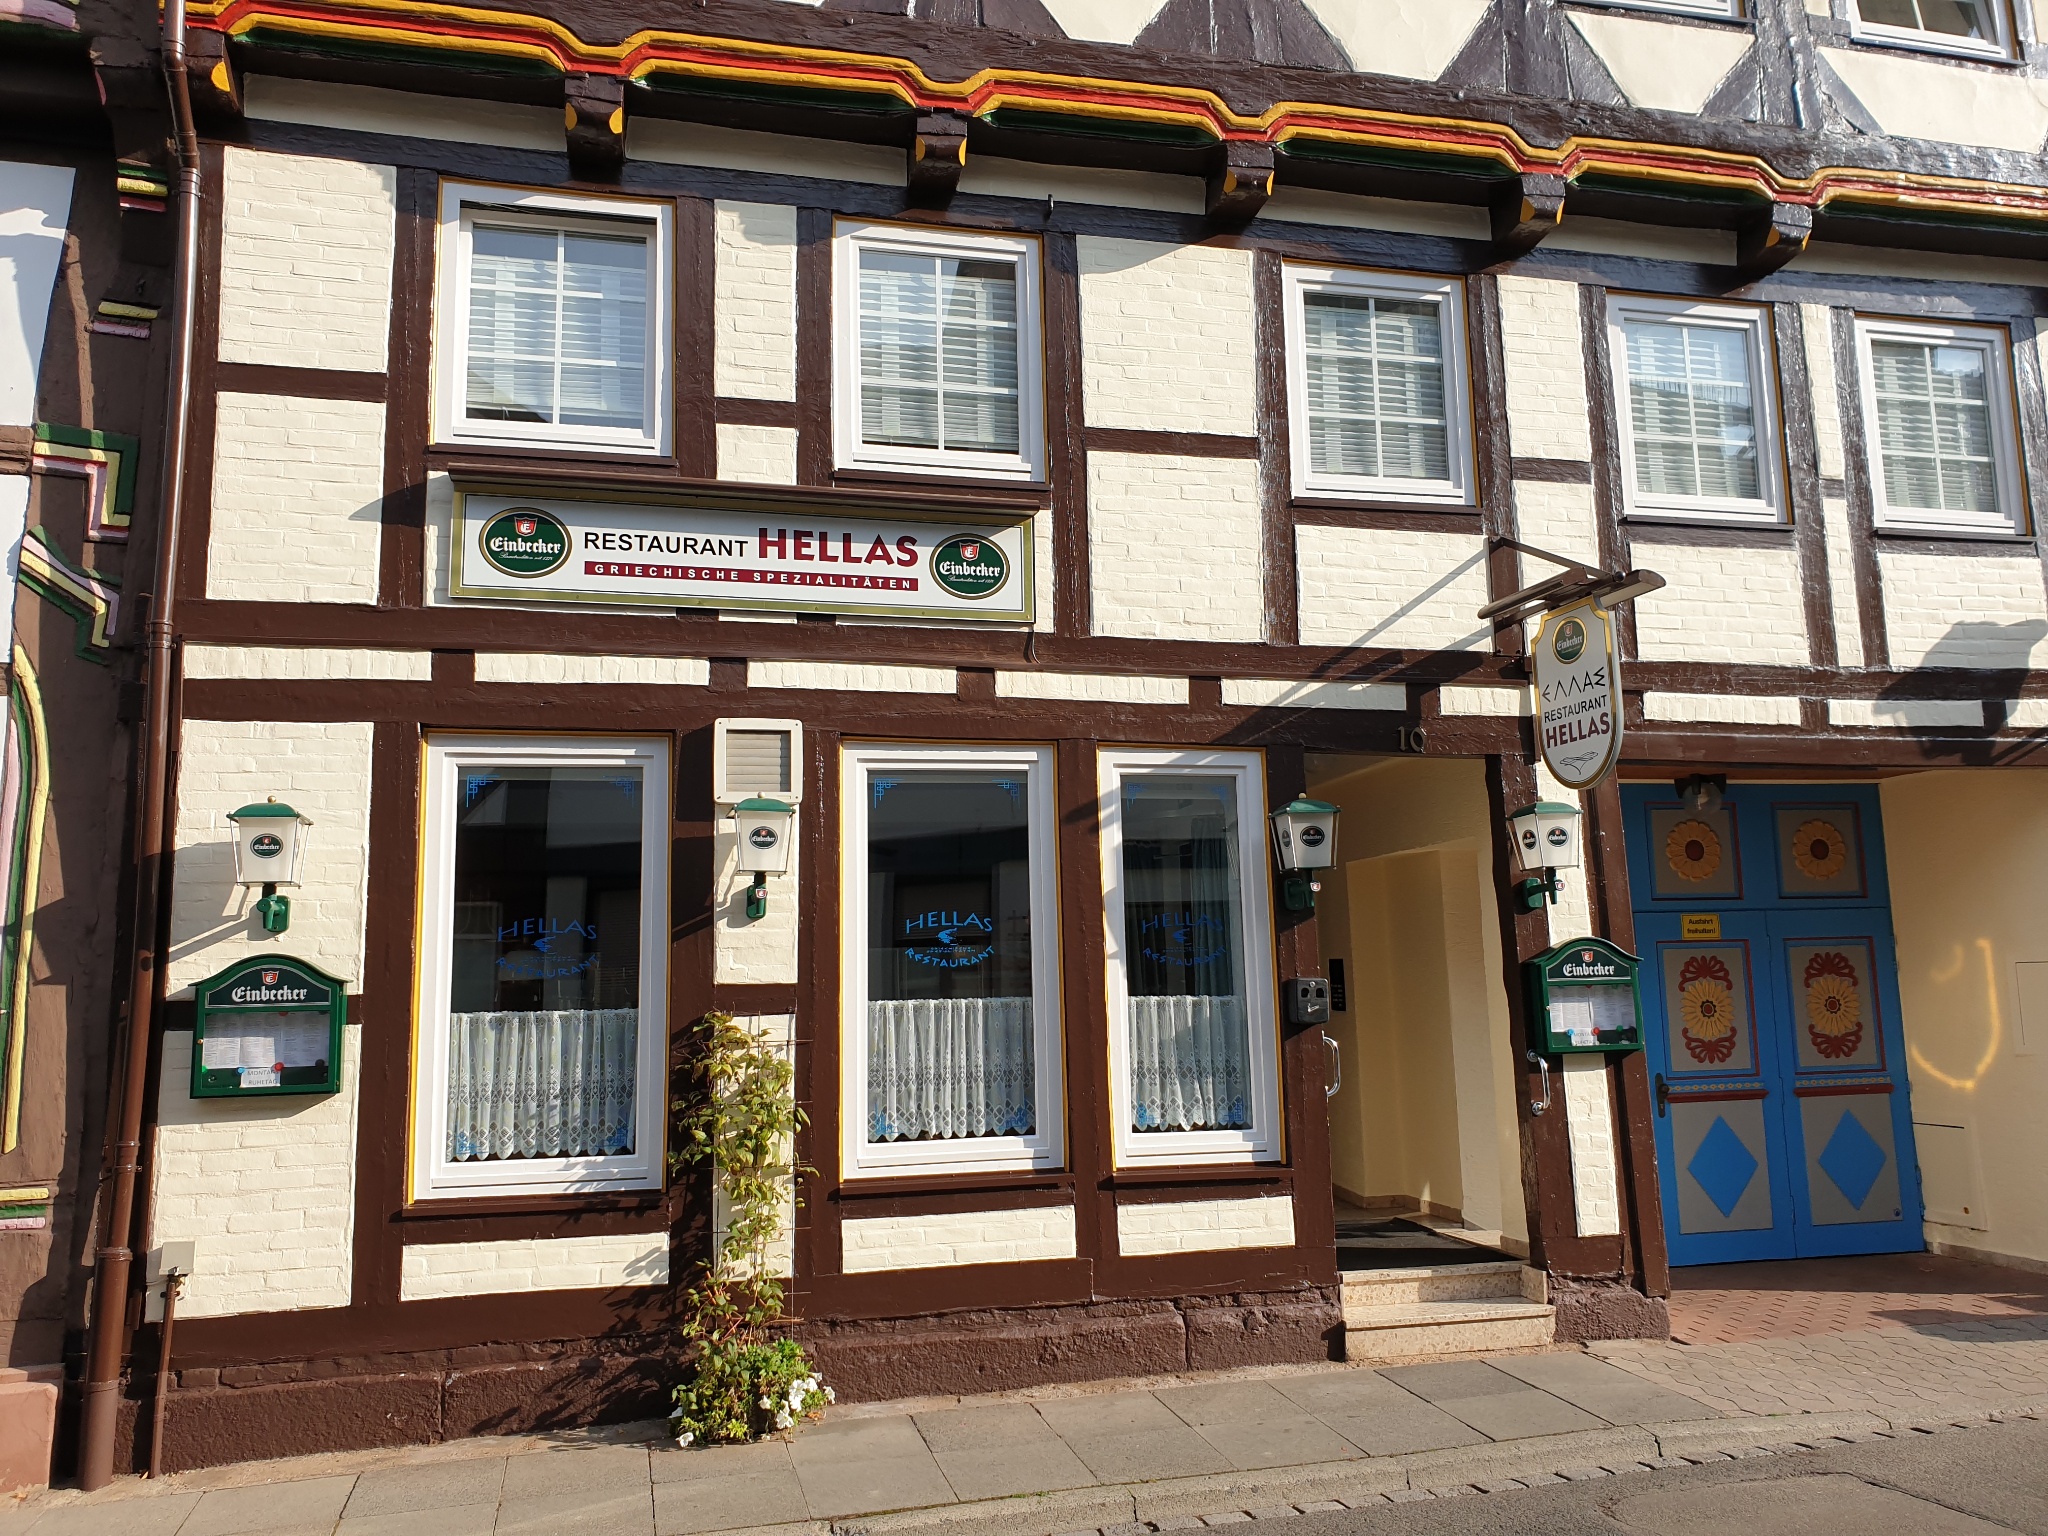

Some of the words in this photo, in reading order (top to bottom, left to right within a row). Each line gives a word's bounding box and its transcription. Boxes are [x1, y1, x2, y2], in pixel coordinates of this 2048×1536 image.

[490, 536, 561, 554] Einbecker
[584, 531, 748, 558] RESTAURANT
[759, 528, 919, 567] HELLAS
[595, 564, 739, 580] GRIECHISCHE
[753, 572, 911, 589] SPEZIALITÄTEN
[940, 561, 1000, 577] Einbecker
[1544, 695, 1607, 723] RESTAURANT
[1398, 726, 1425, 752] 10
[1546, 712, 1610, 749] HELLAS
[497, 918, 597, 942] HELLAS
[905, 911, 993, 934] HELLAS
[1142, 912, 1224, 934] HELLAS
[496, 954, 599, 978] RESTAURANT
[905, 945, 995, 968] RESTAURANT
[1143, 945, 1226, 966] RESTAURANT
[1563, 963, 1614, 976] Einbecker
[231, 985, 307, 1003] Einbecker
